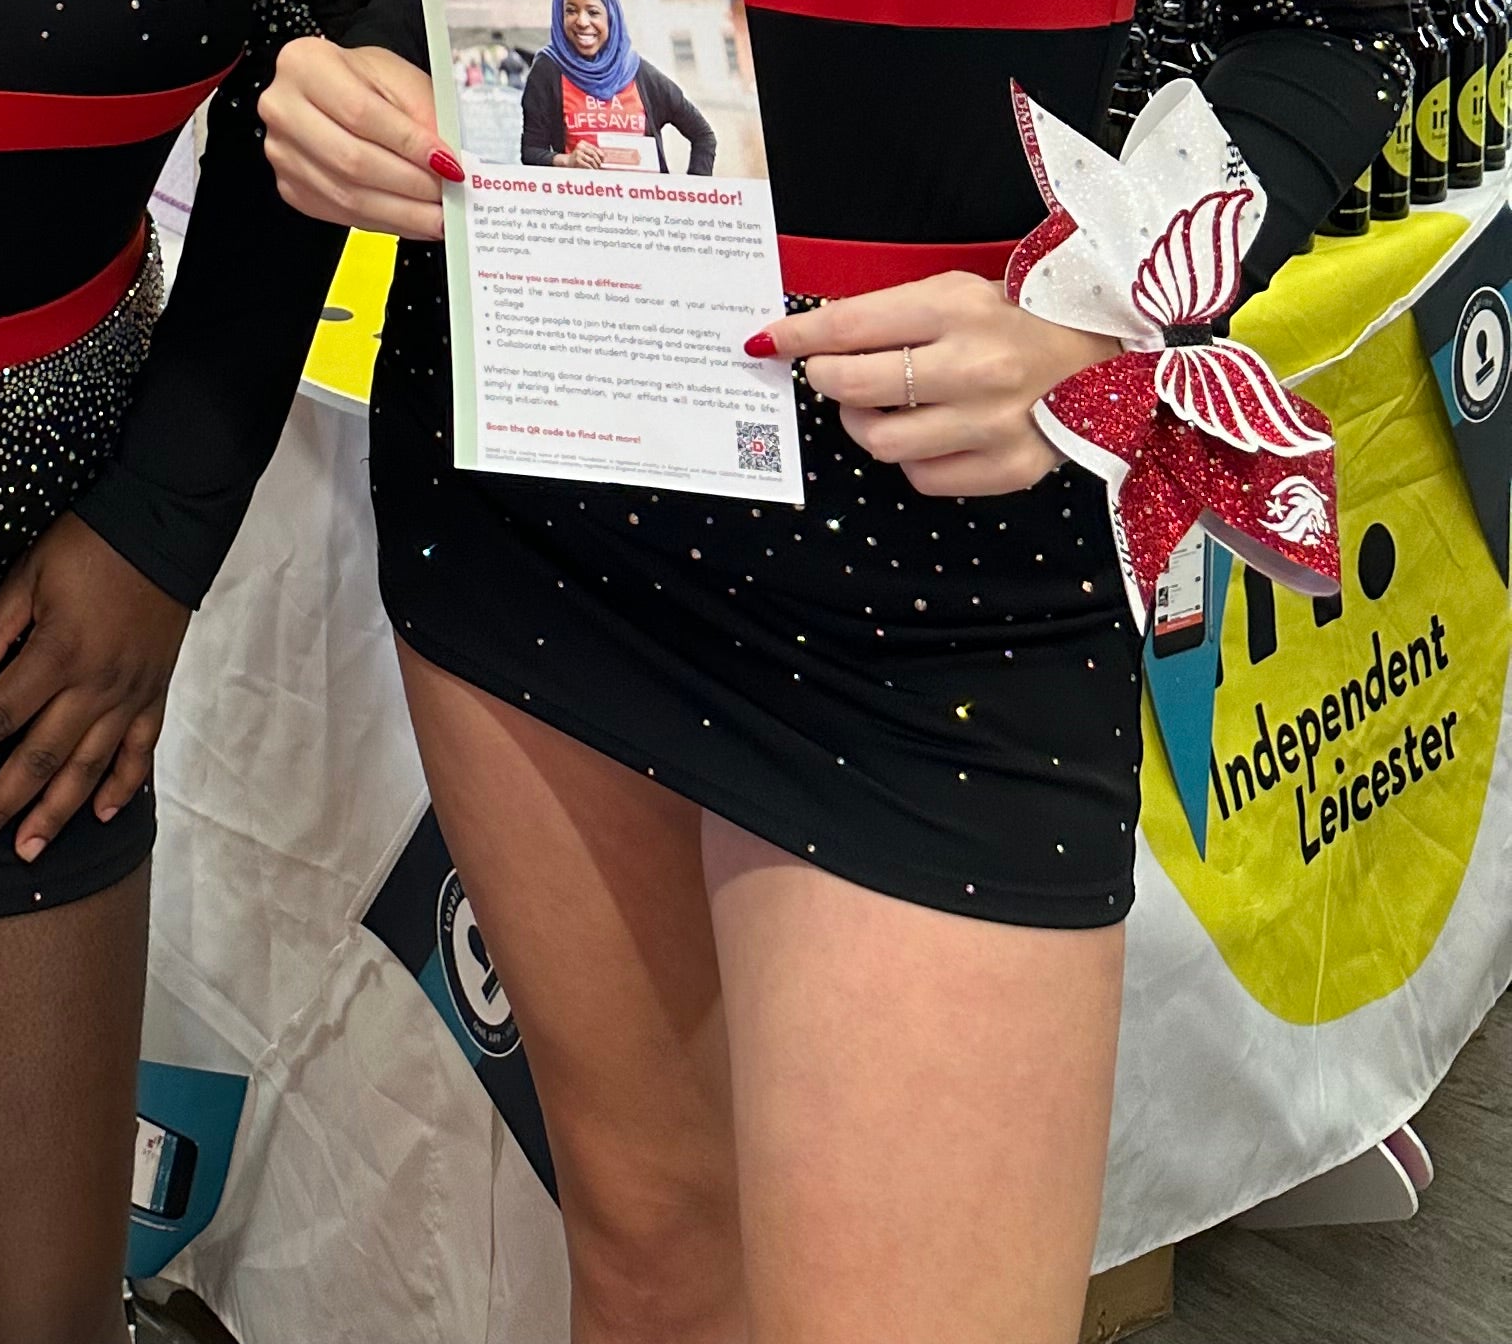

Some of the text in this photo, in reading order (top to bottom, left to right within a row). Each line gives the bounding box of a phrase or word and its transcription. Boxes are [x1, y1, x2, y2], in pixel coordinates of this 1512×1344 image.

[585, 95, 623, 110] BE A
[566, 114, 647, 130] LIFESAVER
[472, 175, 742, 205] Become a student ambassador!
[1211, 614, 1451, 821] Independent
[1297, 711, 1458, 866] Leicester
